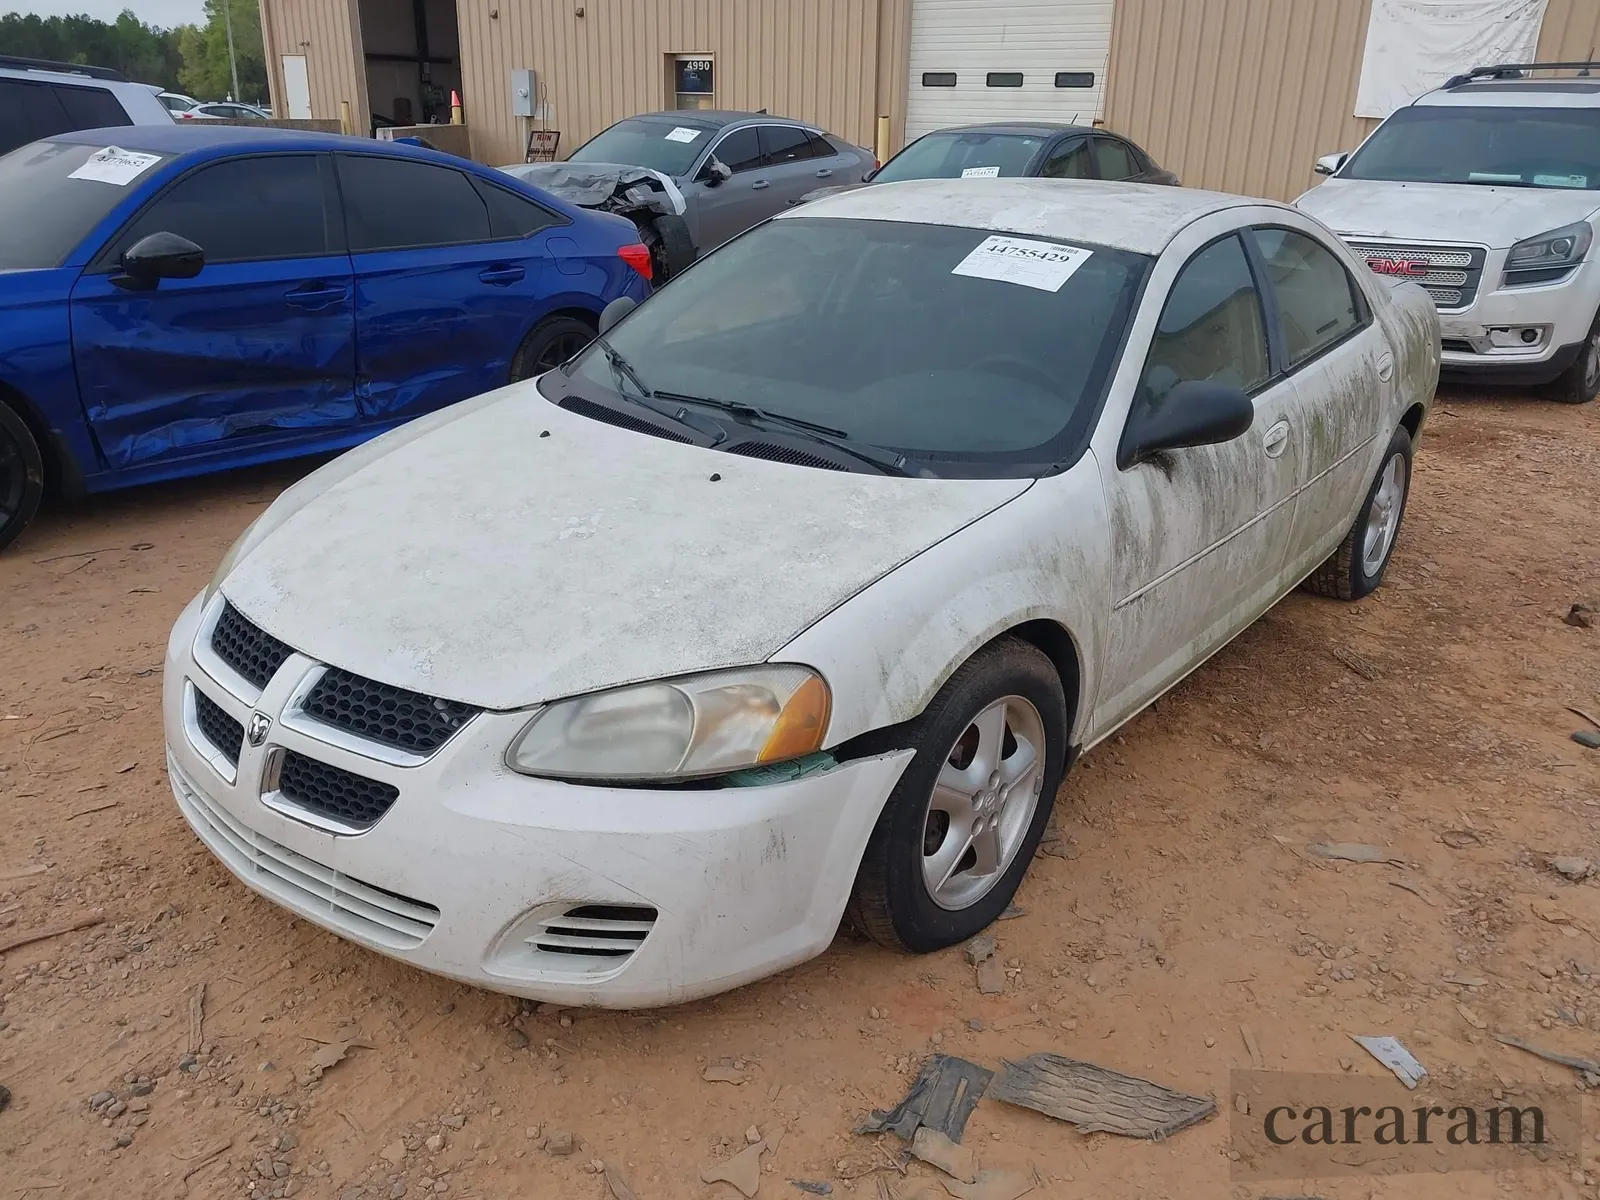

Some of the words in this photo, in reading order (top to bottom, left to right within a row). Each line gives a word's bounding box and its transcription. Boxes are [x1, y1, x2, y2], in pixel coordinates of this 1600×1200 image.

[687, 61, 710, 71] 4990
[536, 134, 552, 142] RUN
[986, 245, 1070, 263] 44755429
[1365, 258, 1429, 276] GMC
